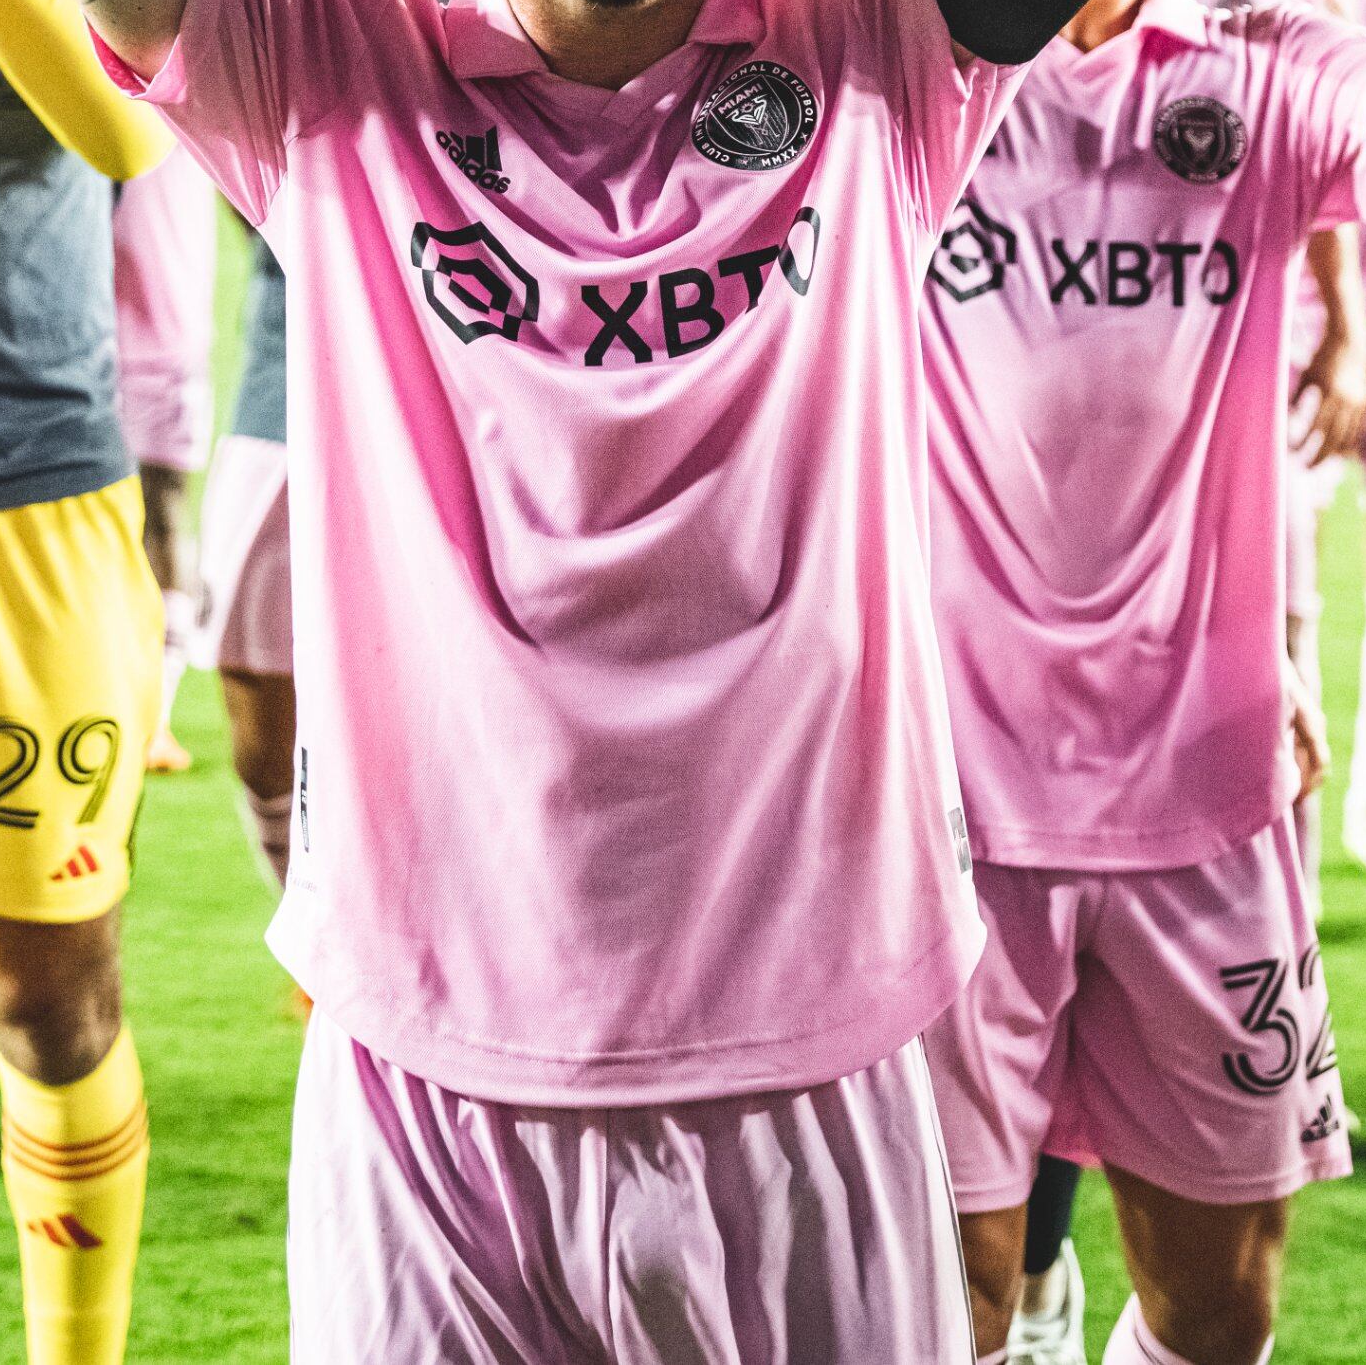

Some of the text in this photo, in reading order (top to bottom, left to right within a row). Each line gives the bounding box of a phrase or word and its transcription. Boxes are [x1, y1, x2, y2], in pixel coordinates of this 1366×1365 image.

[718, 83, 763, 114] MIAMI
[436, 131, 511, 194] adidas
[581, 207, 820, 367] XBTO
[1051, 238, 1236, 307] XBTO
